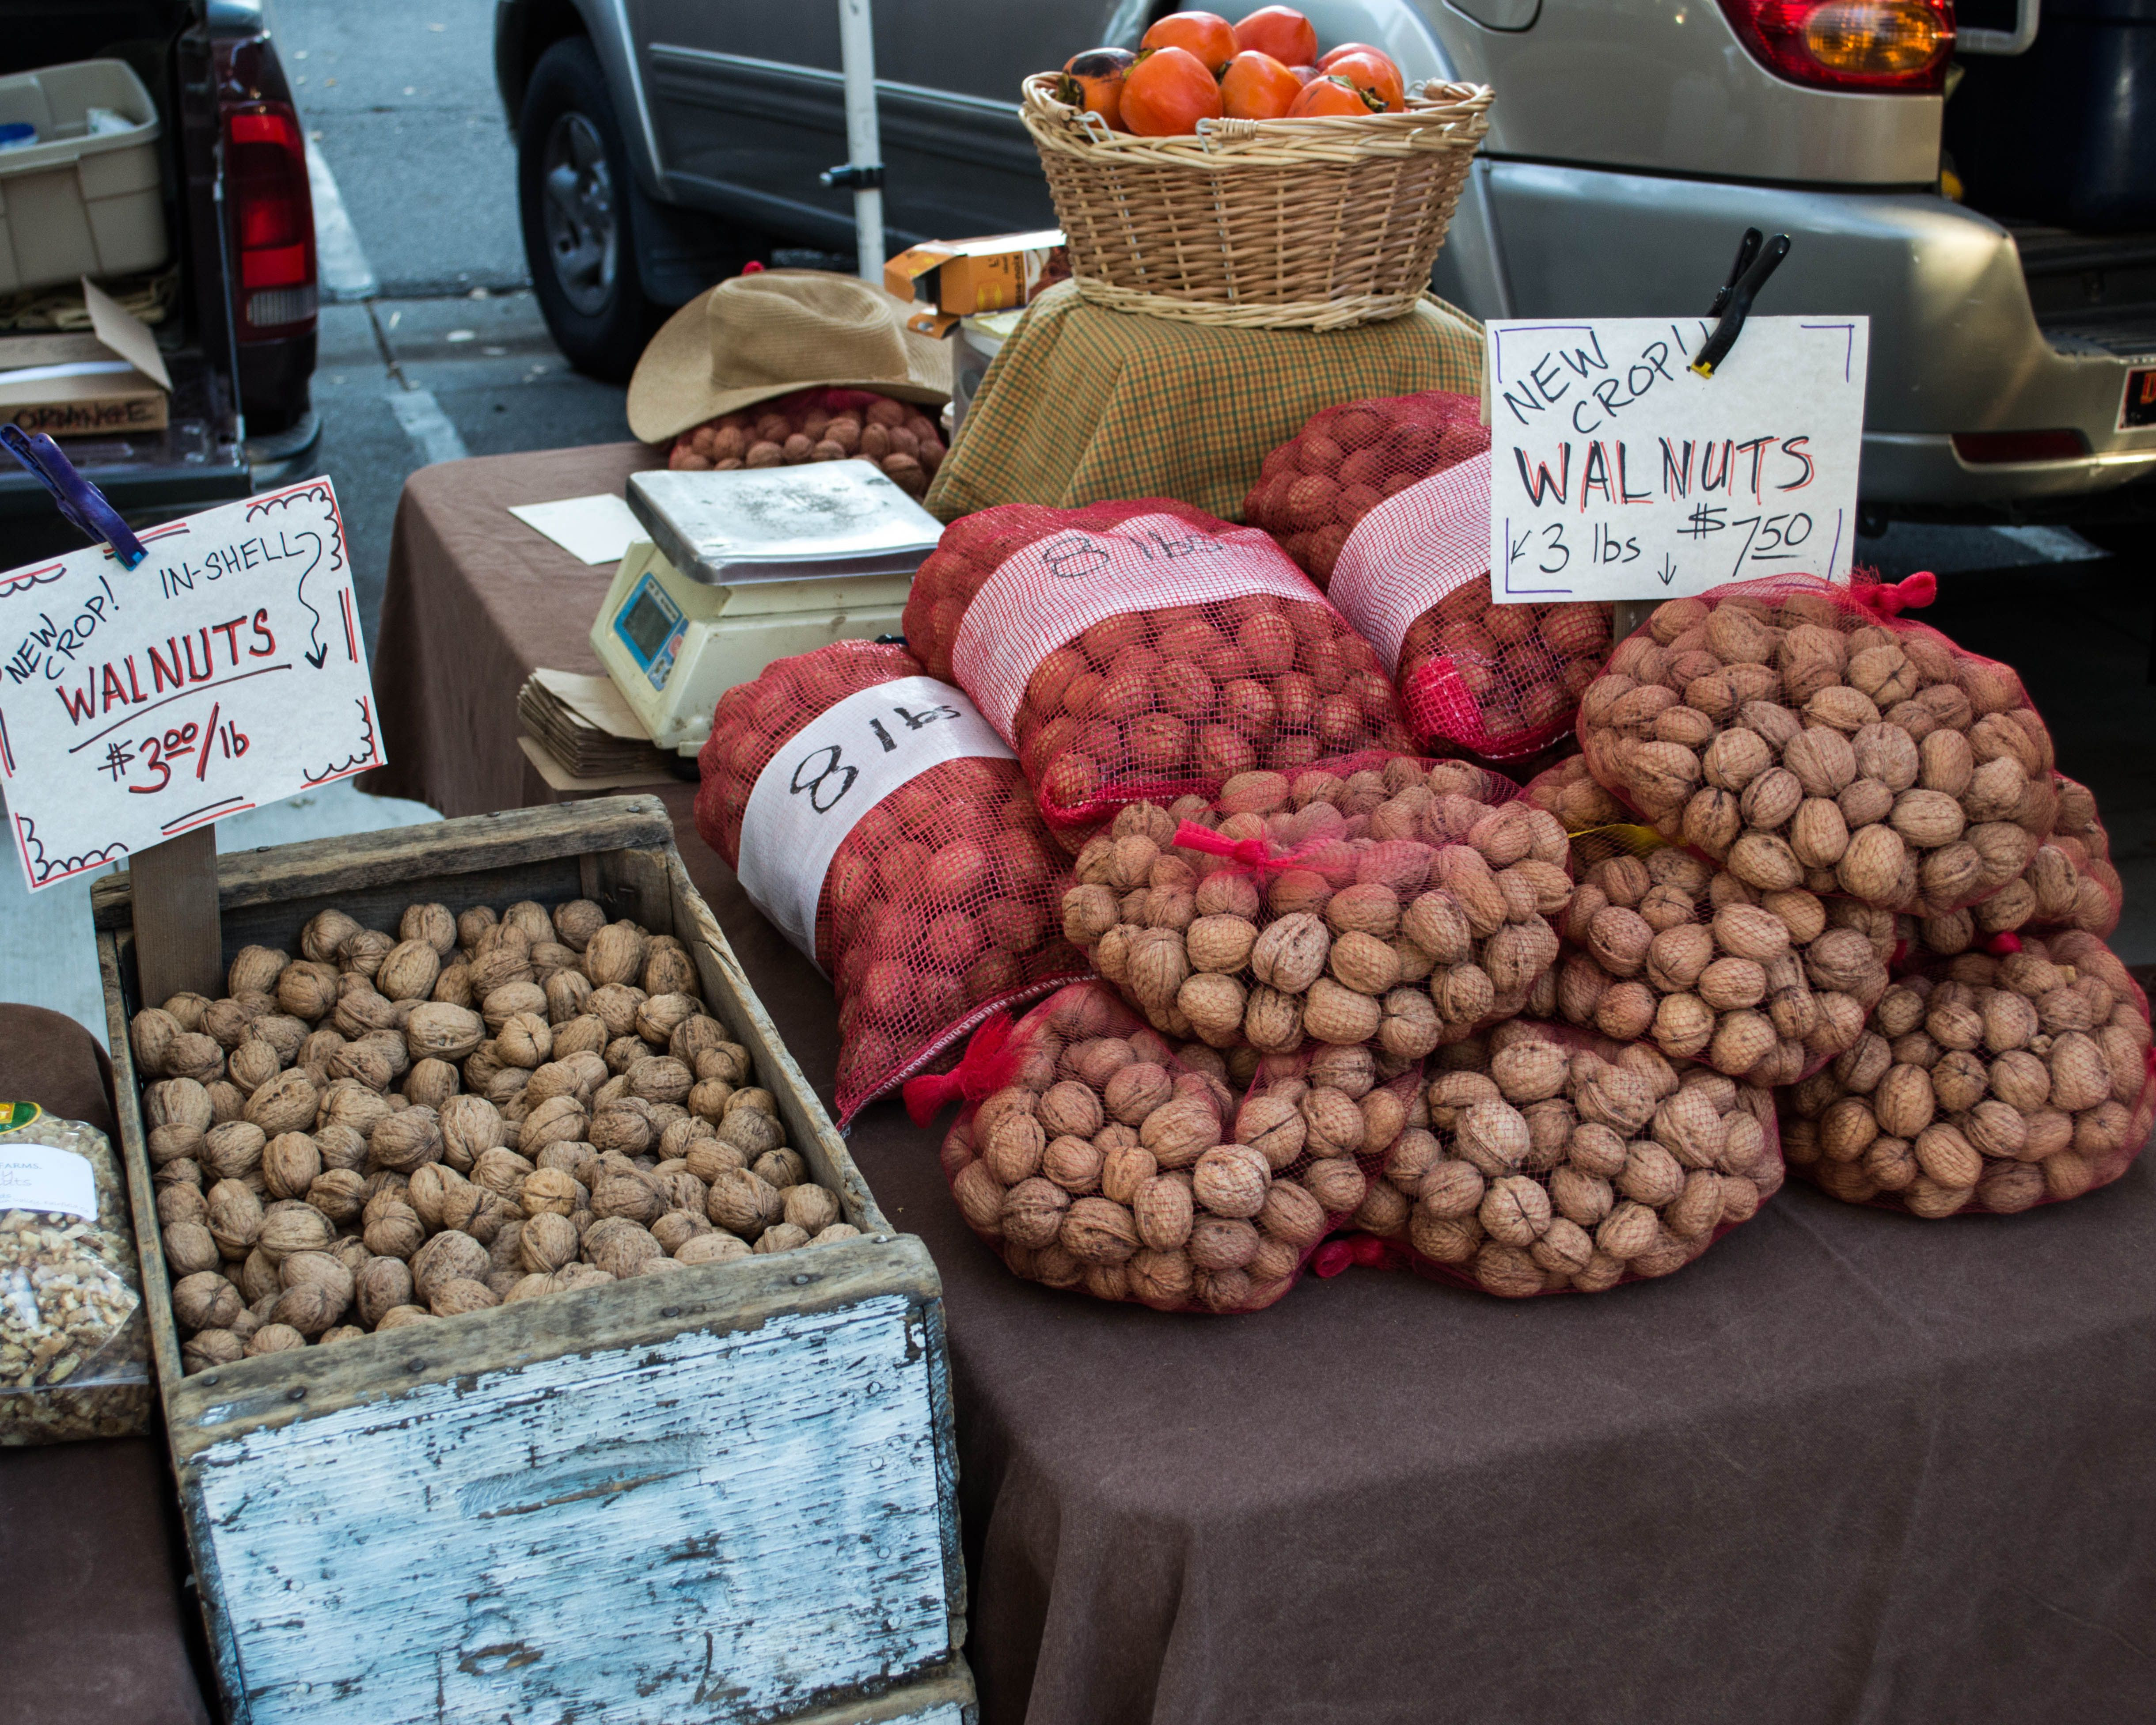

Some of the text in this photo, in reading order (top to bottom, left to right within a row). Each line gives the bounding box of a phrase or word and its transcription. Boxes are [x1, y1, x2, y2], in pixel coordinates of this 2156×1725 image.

[1503, 331, 1609, 425] NEW
[1514, 435, 1814, 513] WALNUTS
[160, 531, 305, 599] IN-SHELL
[1040, 536, 1109, 578] 8
[1539, 524, 1570, 574] 3
[1593, 523, 1641, 565] lbs
[5, 613, 58, 684] NEW
[46, 575, 119, 680] CROP!
[56, 608, 276, 726] WALNUTS
[790, 745, 859, 814] 8
